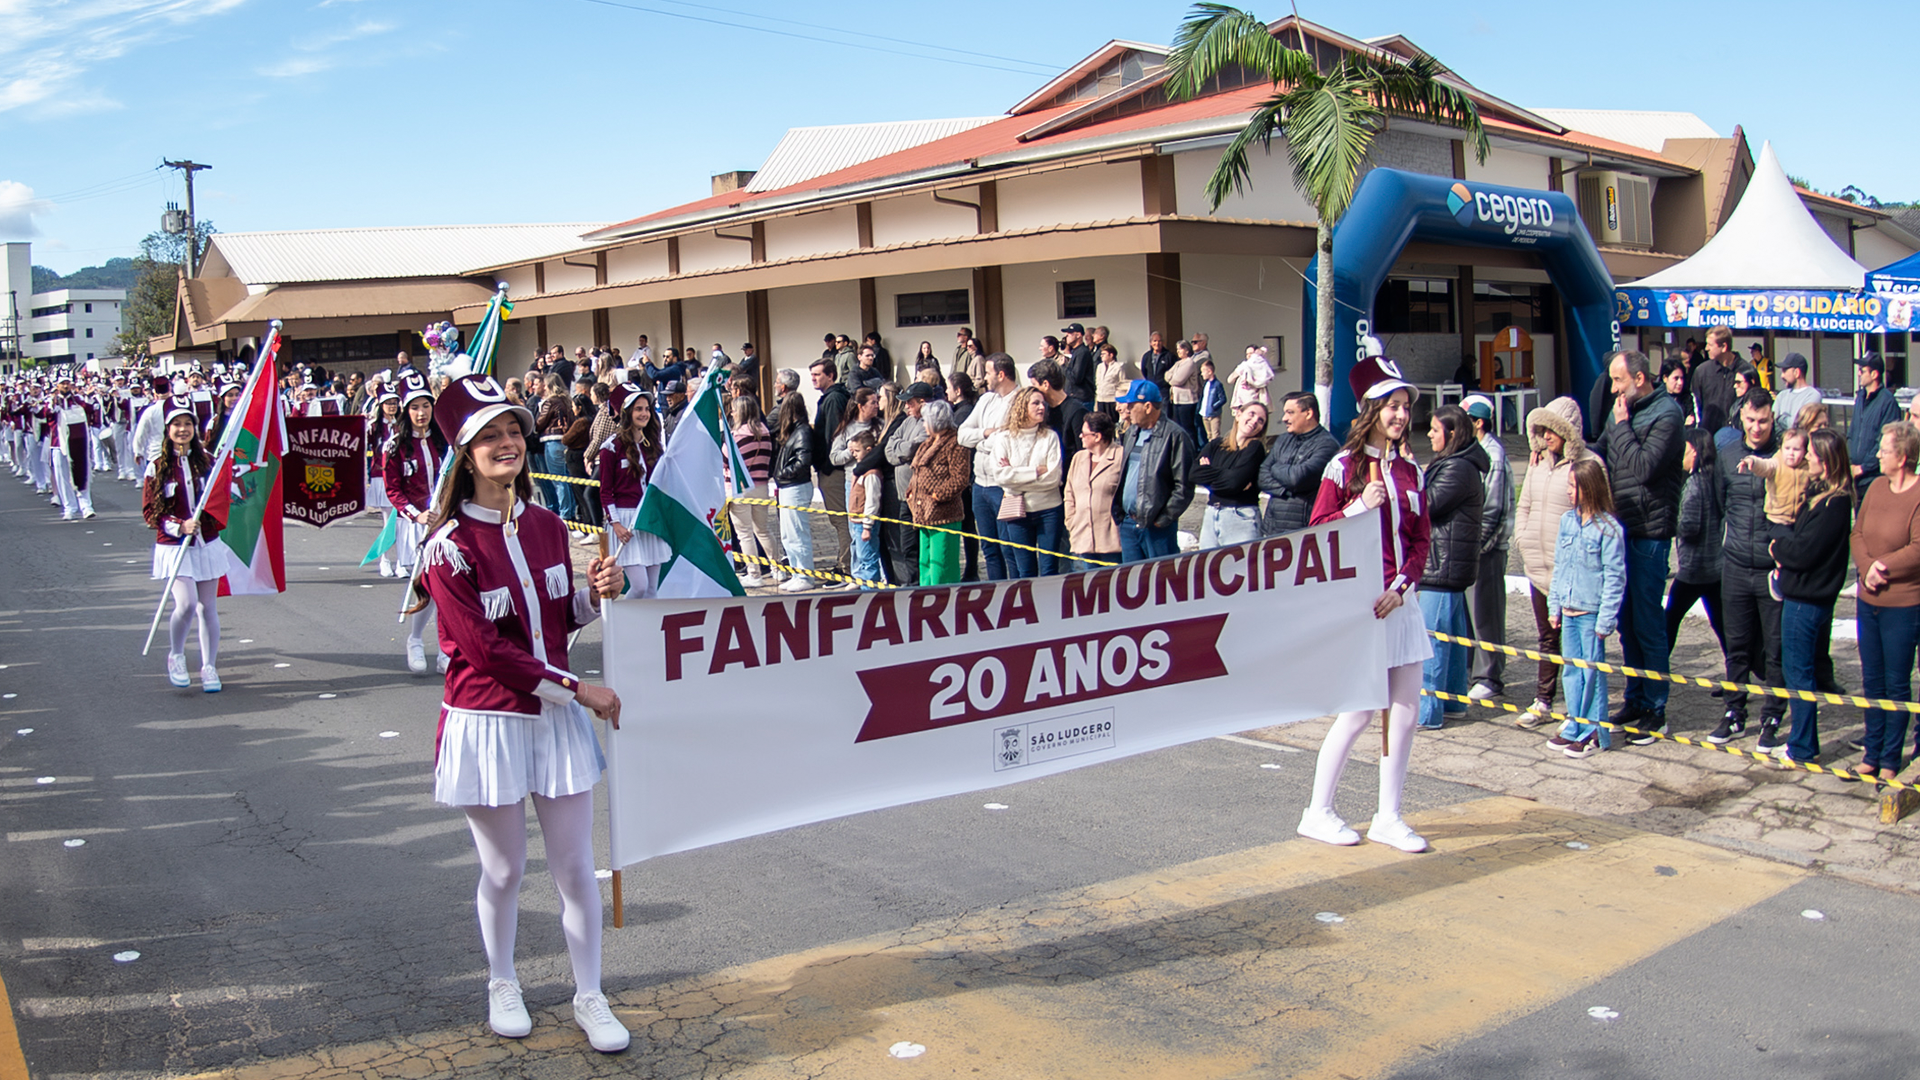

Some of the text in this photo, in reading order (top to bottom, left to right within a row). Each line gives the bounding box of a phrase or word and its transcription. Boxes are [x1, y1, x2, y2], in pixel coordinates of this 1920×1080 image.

[1475, 191, 1553, 235] cegero
[1693, 293, 1881, 316] GALETO SOLIDÁRIO
[1700, 314, 1874, 330] LIONS LUBE SÃO LUDGERO
[289, 428, 360, 452] ANFARRA
[292, 444, 351, 458] MUNICIPAL
[285, 500, 358, 524] SÃO LUDGERO
[317, 501, 327, 510] DE
[661, 530, 1357, 681] FANFARRA MUNICIPAL
[929, 629, 1171, 720] 20 ANOS
[1031, 721, 1112, 746] SÃO LUDGERO
[1031, 733, 1111, 752] GOVERNO MUNICIPAL
